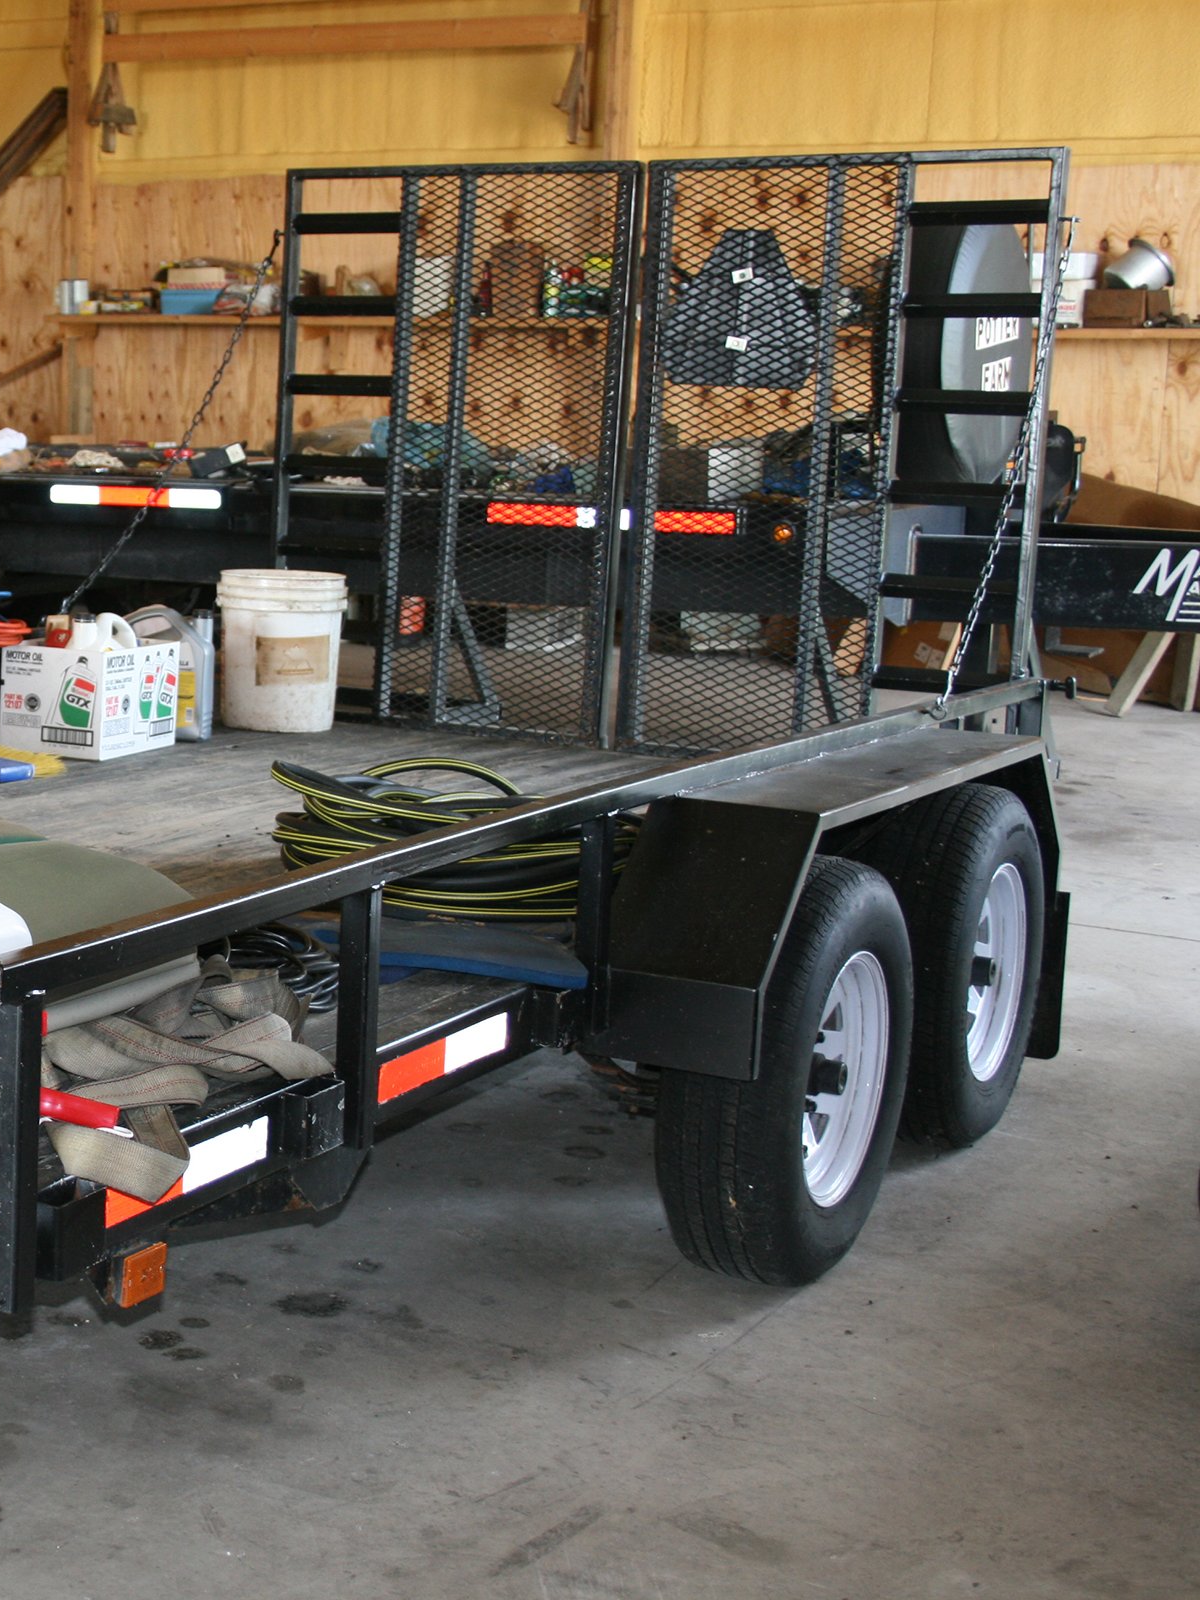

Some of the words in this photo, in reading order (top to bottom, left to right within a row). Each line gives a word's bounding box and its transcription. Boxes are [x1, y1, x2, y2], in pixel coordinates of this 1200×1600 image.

[977, 316, 1018, 348] POTTER
[5, 650, 31, 661] MOTOR
[32, 652, 43, 662] OIL
[106, 655, 126, 669] MOTOR
[126, 654, 135, 666] OIL
[66, 693, 92, 709] GTX
[160, 692, 174, 705] GTX
